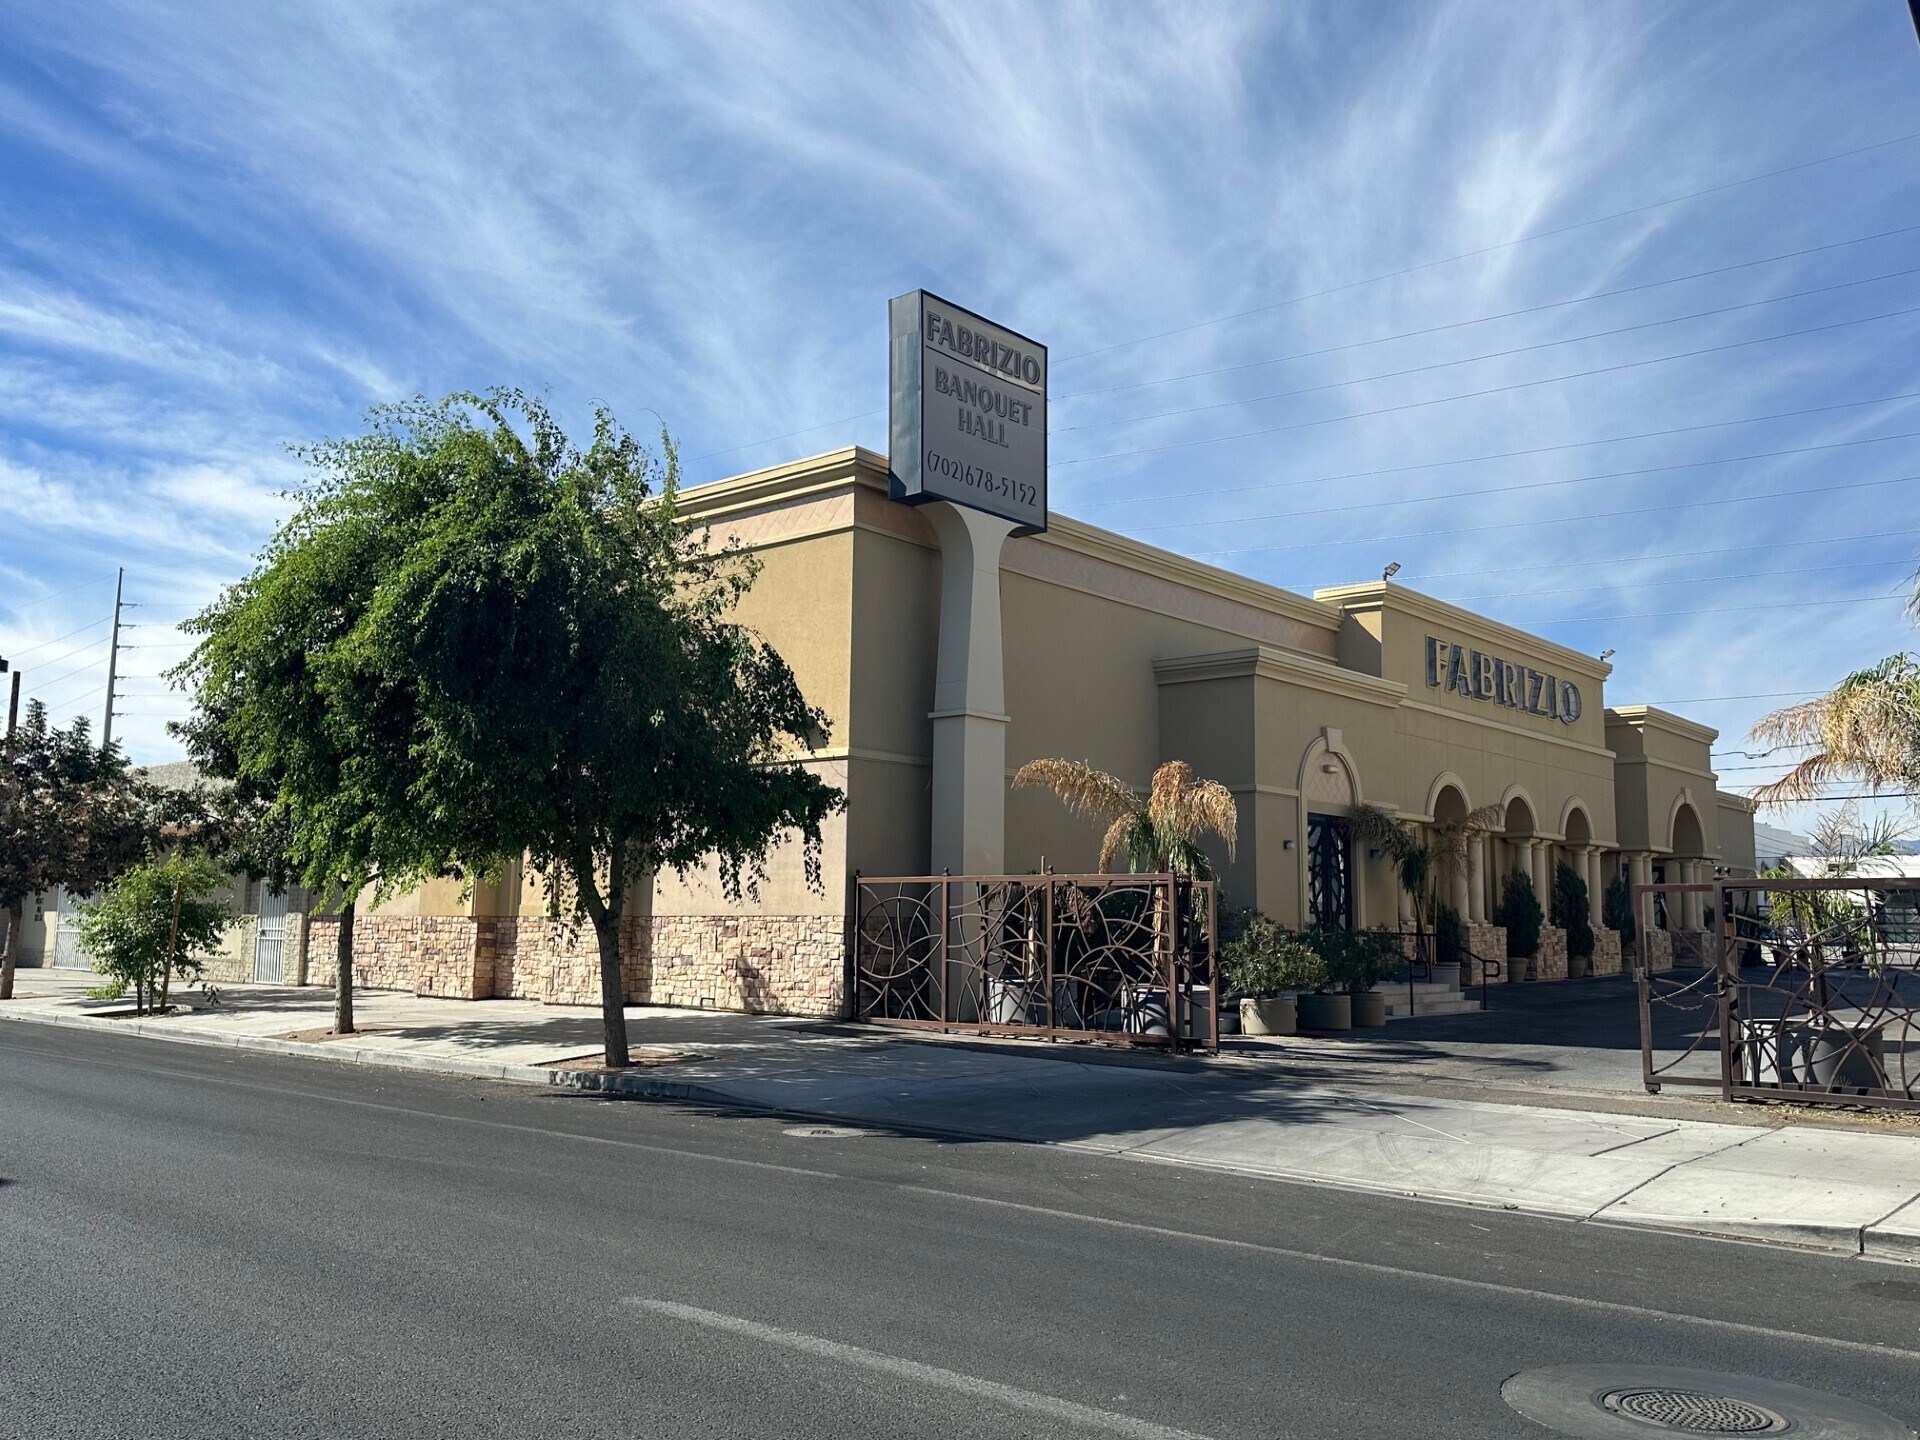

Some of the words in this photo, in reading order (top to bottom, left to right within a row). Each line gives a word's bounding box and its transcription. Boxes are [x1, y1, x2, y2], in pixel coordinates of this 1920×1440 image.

[926, 310, 1041, 385] FABRIZIO
[935, 365, 1032, 426] BANQUET
[957, 408, 1009, 448] HALL
[926, 450, 1037, 507] (702)678-5152
[1425, 634, 1582, 726] FABRIZIO
